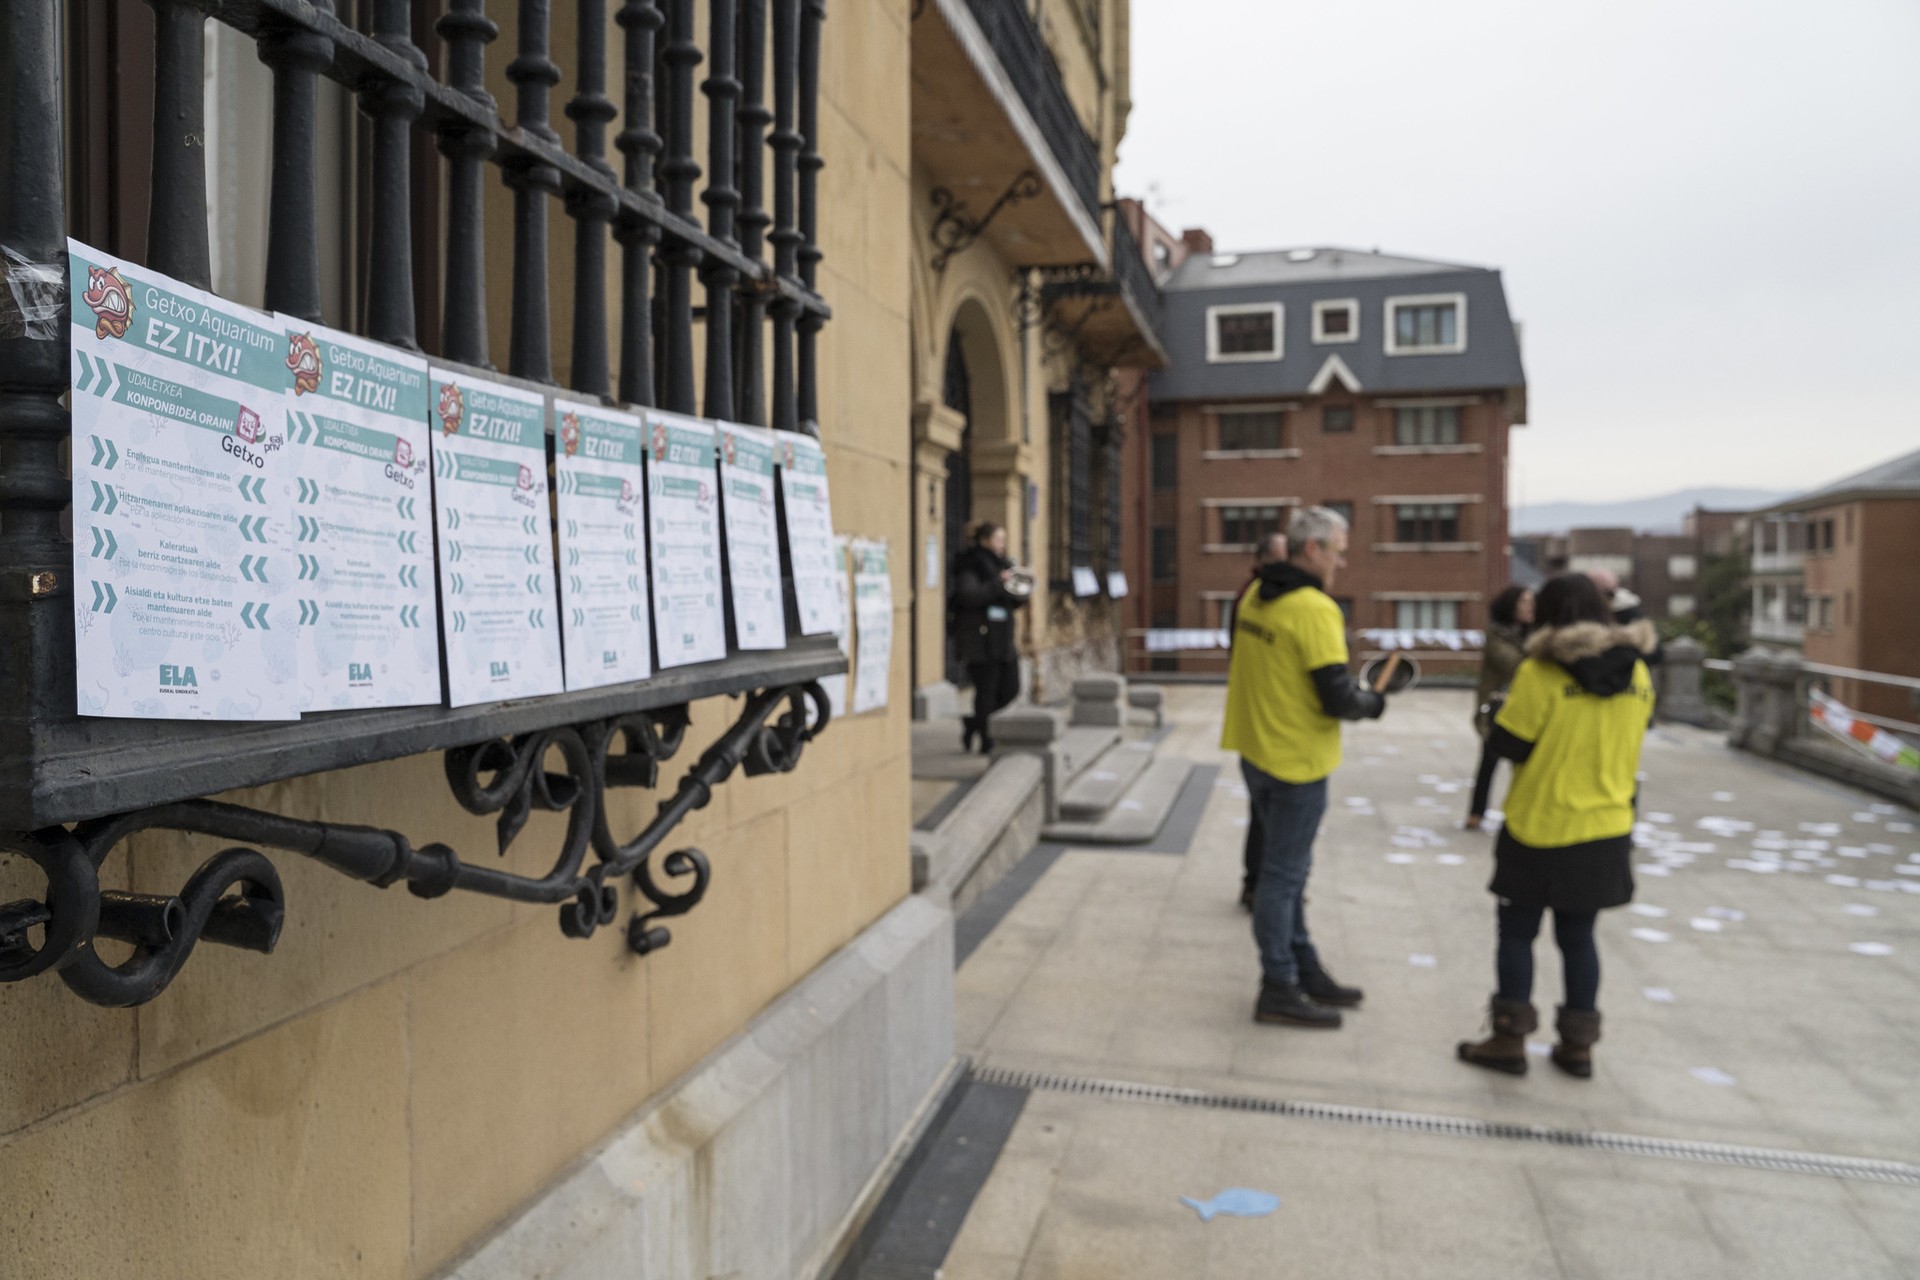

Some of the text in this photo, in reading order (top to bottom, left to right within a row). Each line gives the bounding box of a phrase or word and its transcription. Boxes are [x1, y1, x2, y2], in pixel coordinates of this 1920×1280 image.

[145, 288, 275, 352] Getxo Aquarium
[145, 317, 242, 375] EZ ITXI!
[329, 345, 420, 388] Getxo Aquarium
[127, 371, 183, 398] UDALETXEA
[330, 371, 397, 411] EZ ITXI!
[127, 390, 234, 431] KONPONBIDEA ORAIN!
[469, 413, 522, 443] EZ ITXI!
[221, 435, 264, 468] Getxo
[161, 460, 215, 478] mantentzearen
[216, 472, 231, 482] alde
[384, 463, 415, 490] Getxo
[119, 491, 173, 511] Hitzarmenaren
[223, 513, 238, 523] alde
[138, 548, 221, 570] berriz onartzearen alde
[159, 540, 198, 554] Kaleratuak
[125, 586, 233, 608] Aisialdi eta kultura etxe baten
[147, 603, 213, 618] mantenuaren alde
[159, 664, 198, 687] ELA
[349, 663, 372, 680] ELA
